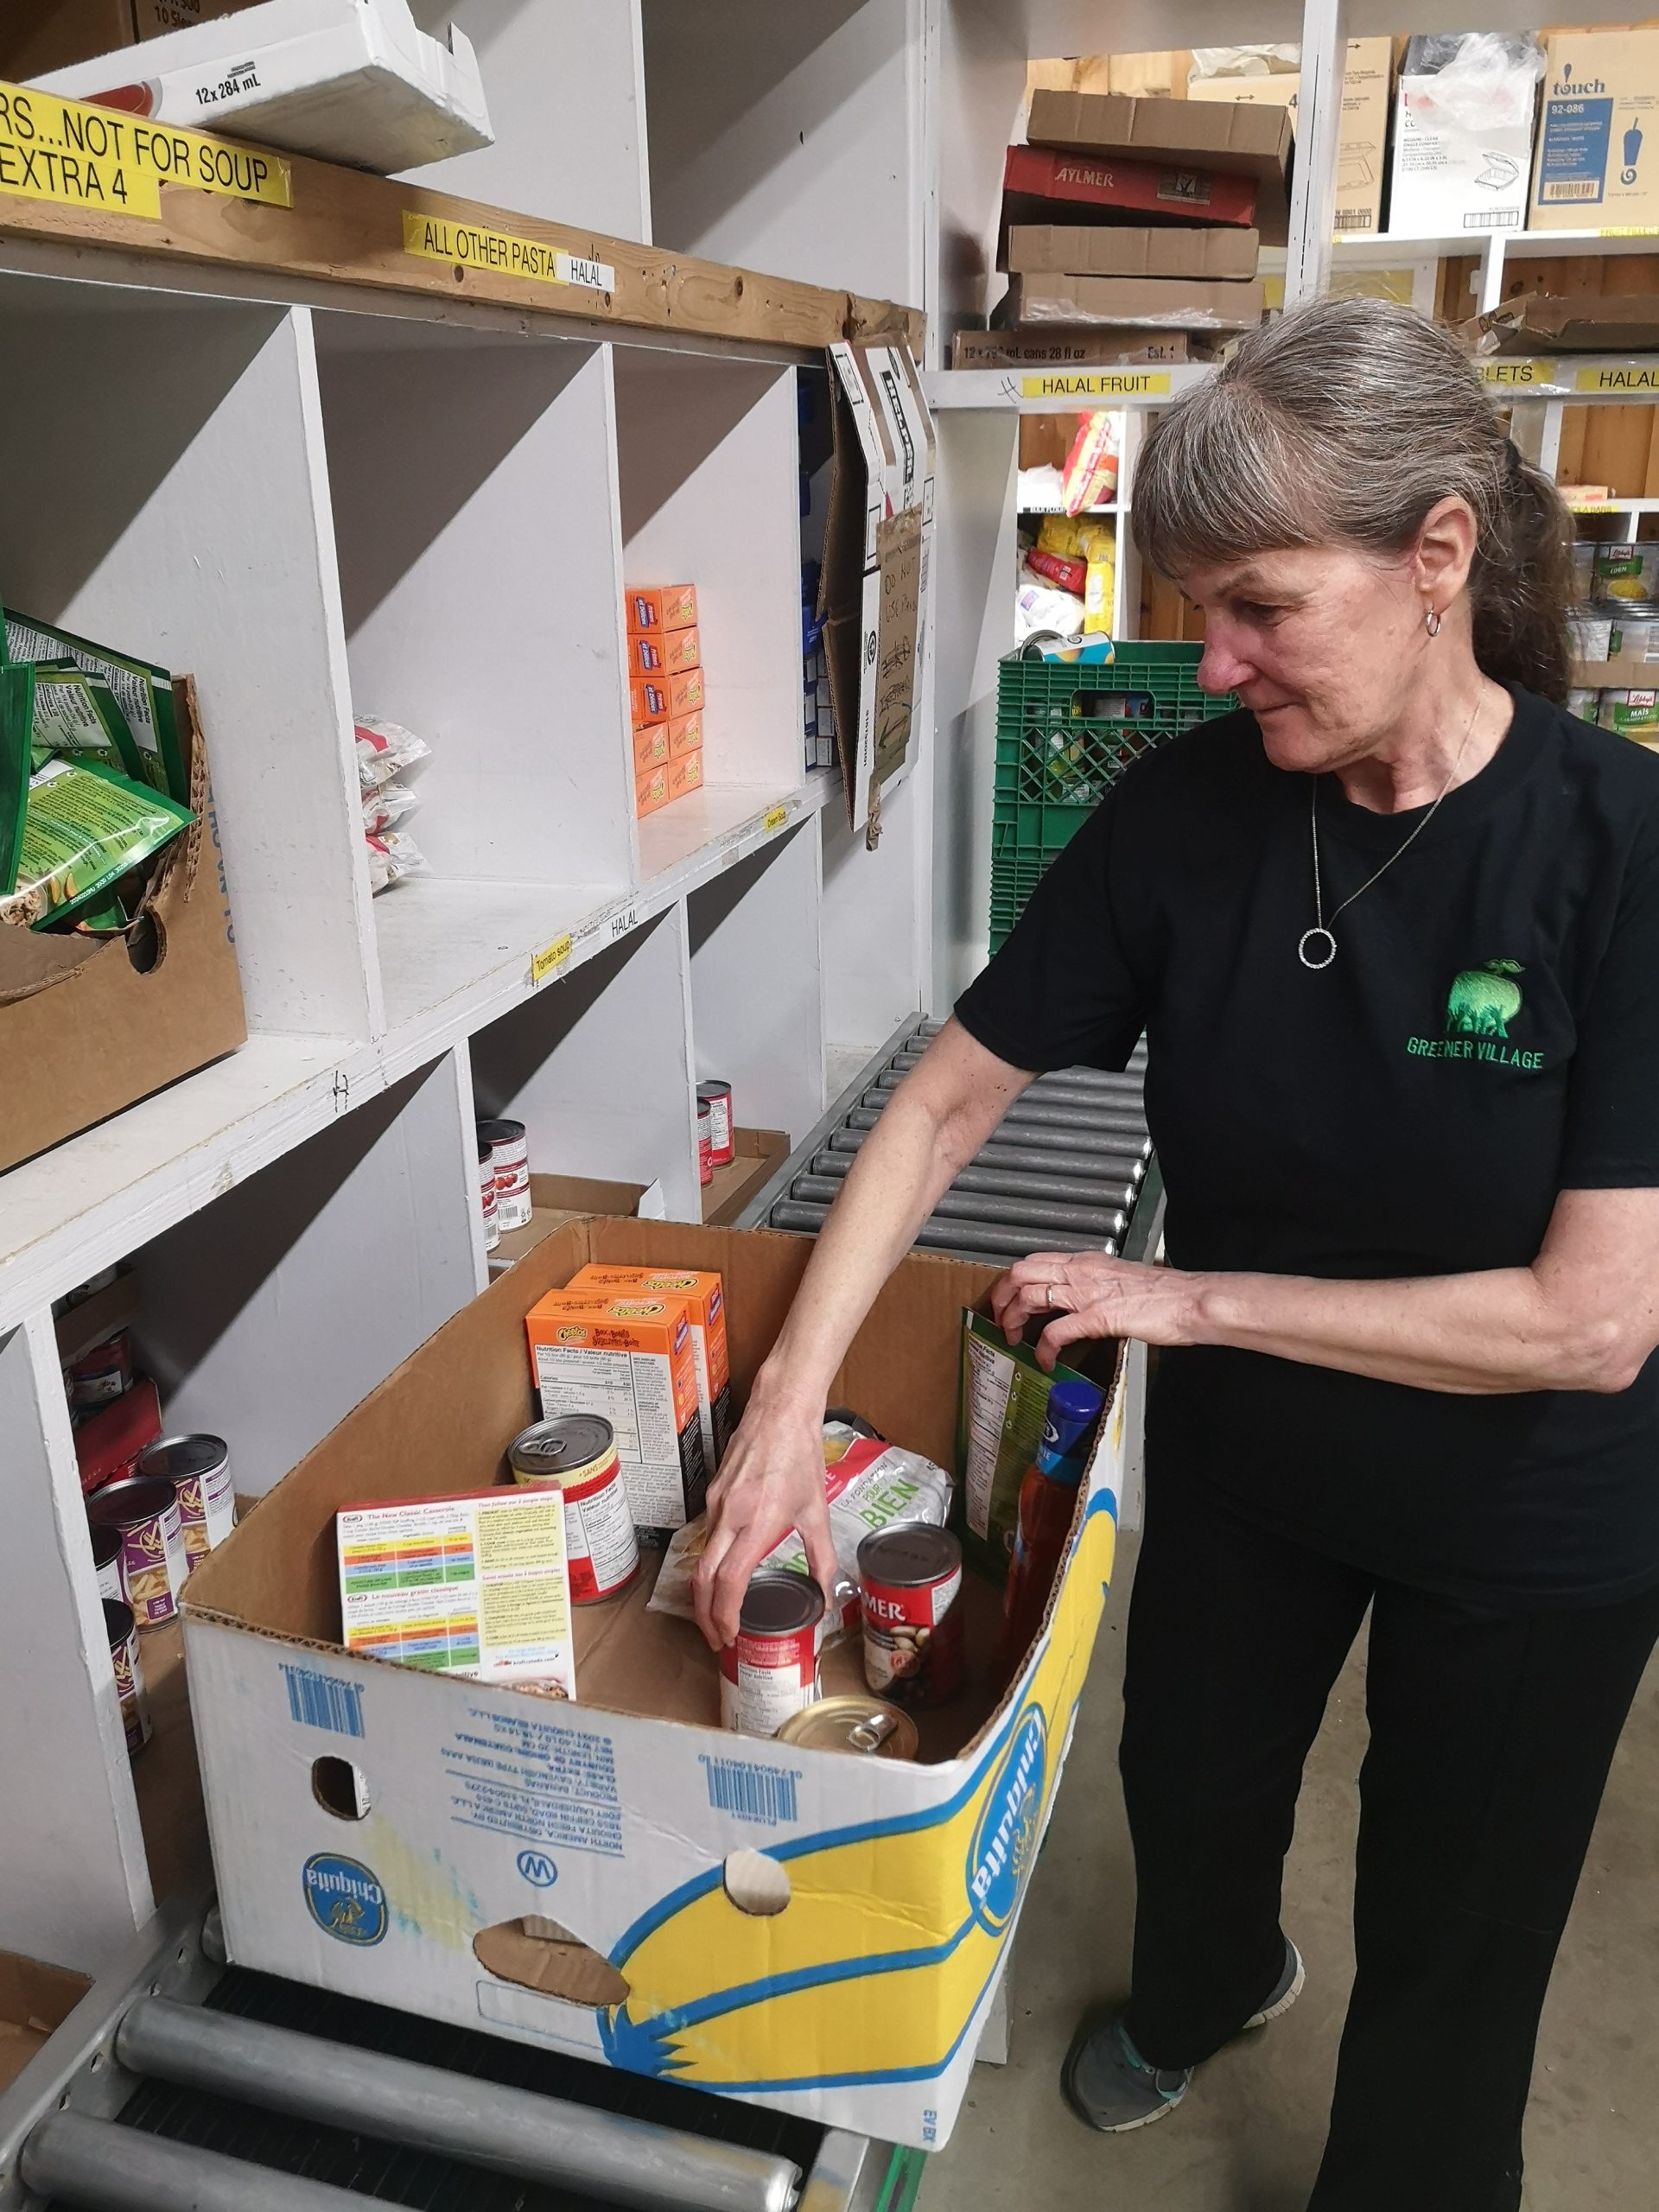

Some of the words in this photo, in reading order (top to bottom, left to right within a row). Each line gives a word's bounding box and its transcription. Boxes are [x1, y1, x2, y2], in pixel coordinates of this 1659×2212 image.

[219, 80, 240, 99] 284
[243, 73, 261, 91] mL
[1553, 79, 1605, 95] touch
[1551, 104, 1585, 114] 92-086
[0, 142, 105, 201] EXTRA
[112, 168, 128, 204] 4
[135, 128, 191, 177] FOR
[200, 145, 268, 193] SOUP
[1055, 167, 1114, 188] AYLMER
[424, 222, 453, 255] ALL
[456, 229, 508, 268] OTHER
[512, 243, 556, 277] PASTA
[571, 259, 602, 287] HALAL
[964, 347, 975, 359] 12
[1024, 348, 1046, 359] cans
[1049, 347, 1061, 359] 28
[1074, 349, 1085, 359] oz
[1043, 378, 1095, 393] HALAL
[1101, 376, 1150, 392] FRUIT
[1600, 372, 1659, 387] HALAL
[884, 378, 913, 480] HELPER
[45, 683, 54, 709] Calories
[73, 684, 89, 710] Nutrition
[86, 709, 97, 724] Facts
[139, 677, 148, 709] Nutrition
[66, 684, 78, 709] Valeur
[74, 706, 89, 728] nutritive
[135, 698, 143, 723] nutritive
[612, 909, 639, 938] HALAL
[537, 951, 556, 971] Tomato
[557, 940, 570, 957] soup
[1407, 1037, 1473, 1058] GREENER
[1478, 1041, 1545, 1070] VILLAGE
[643, 1279, 698, 1290] Cheetos
[607, 1304, 664, 1317] Cheetos
[556, 1325, 588, 1342] Cheetos
[582, 1464, 599, 1478] SANS
[580, 1492, 605, 1506] Nutrition
[605, 1483, 617, 1495] Facts
[841, 1498, 854, 1508] LA
[851, 1461, 888, 1498] FONDATION
[862, 1484, 883, 1502] POUR
[423, 1506, 455, 1515] Casserole
[582, 1501, 601, 1513] Valeur
[601, 1488, 619, 1505] nutritive
[860, 1478, 919, 1529] BIEN
[431, 1586, 459, 1595] classique
[454, 1732, 512, 1753] GUATEMALA
[524, 1778, 569, 1794] BANANAS
[971, 1709, 1042, 1898] Chiquita
[590, 1837, 622, 1850] NORTH
[306, 1868, 382, 1905] Chiquita
